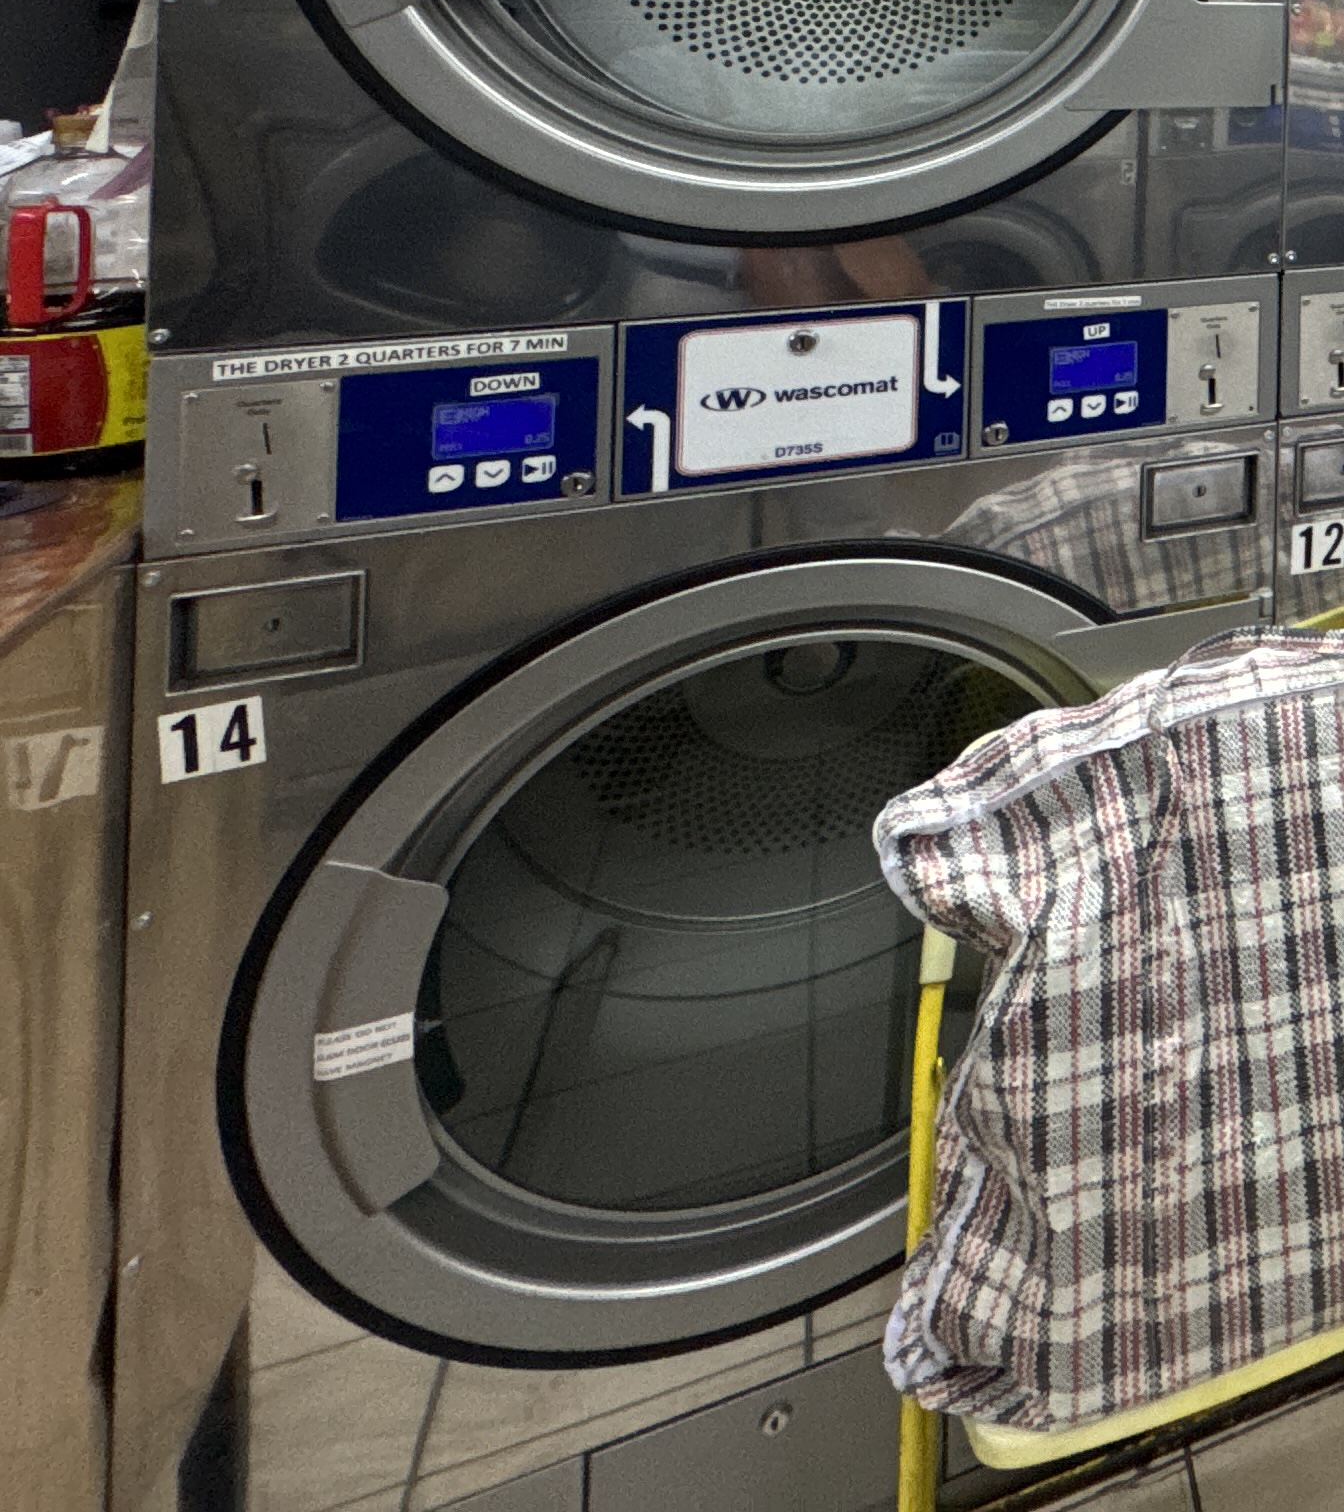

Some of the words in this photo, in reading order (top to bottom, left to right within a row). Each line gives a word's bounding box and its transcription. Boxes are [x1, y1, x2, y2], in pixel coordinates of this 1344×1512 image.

[1088, 326, 1106, 337] UP
[218, 361, 257, 378] THE
[264, 355, 331, 374] DRYER
[338, 354, 350, 367] 2
[355, 343, 461, 365] QUARTERS
[466, 340, 503, 355] FOR
[510, 338, 520, 352] 7
[526, 336, 564, 350] MIN
[473, 375, 537, 392] DOWN
[774, 376, 898, 402] wascomat
[775, 443, 823, 458] D735S
[1299, 523, 1344, 569] 12
[171, 704, 257, 773] 14
